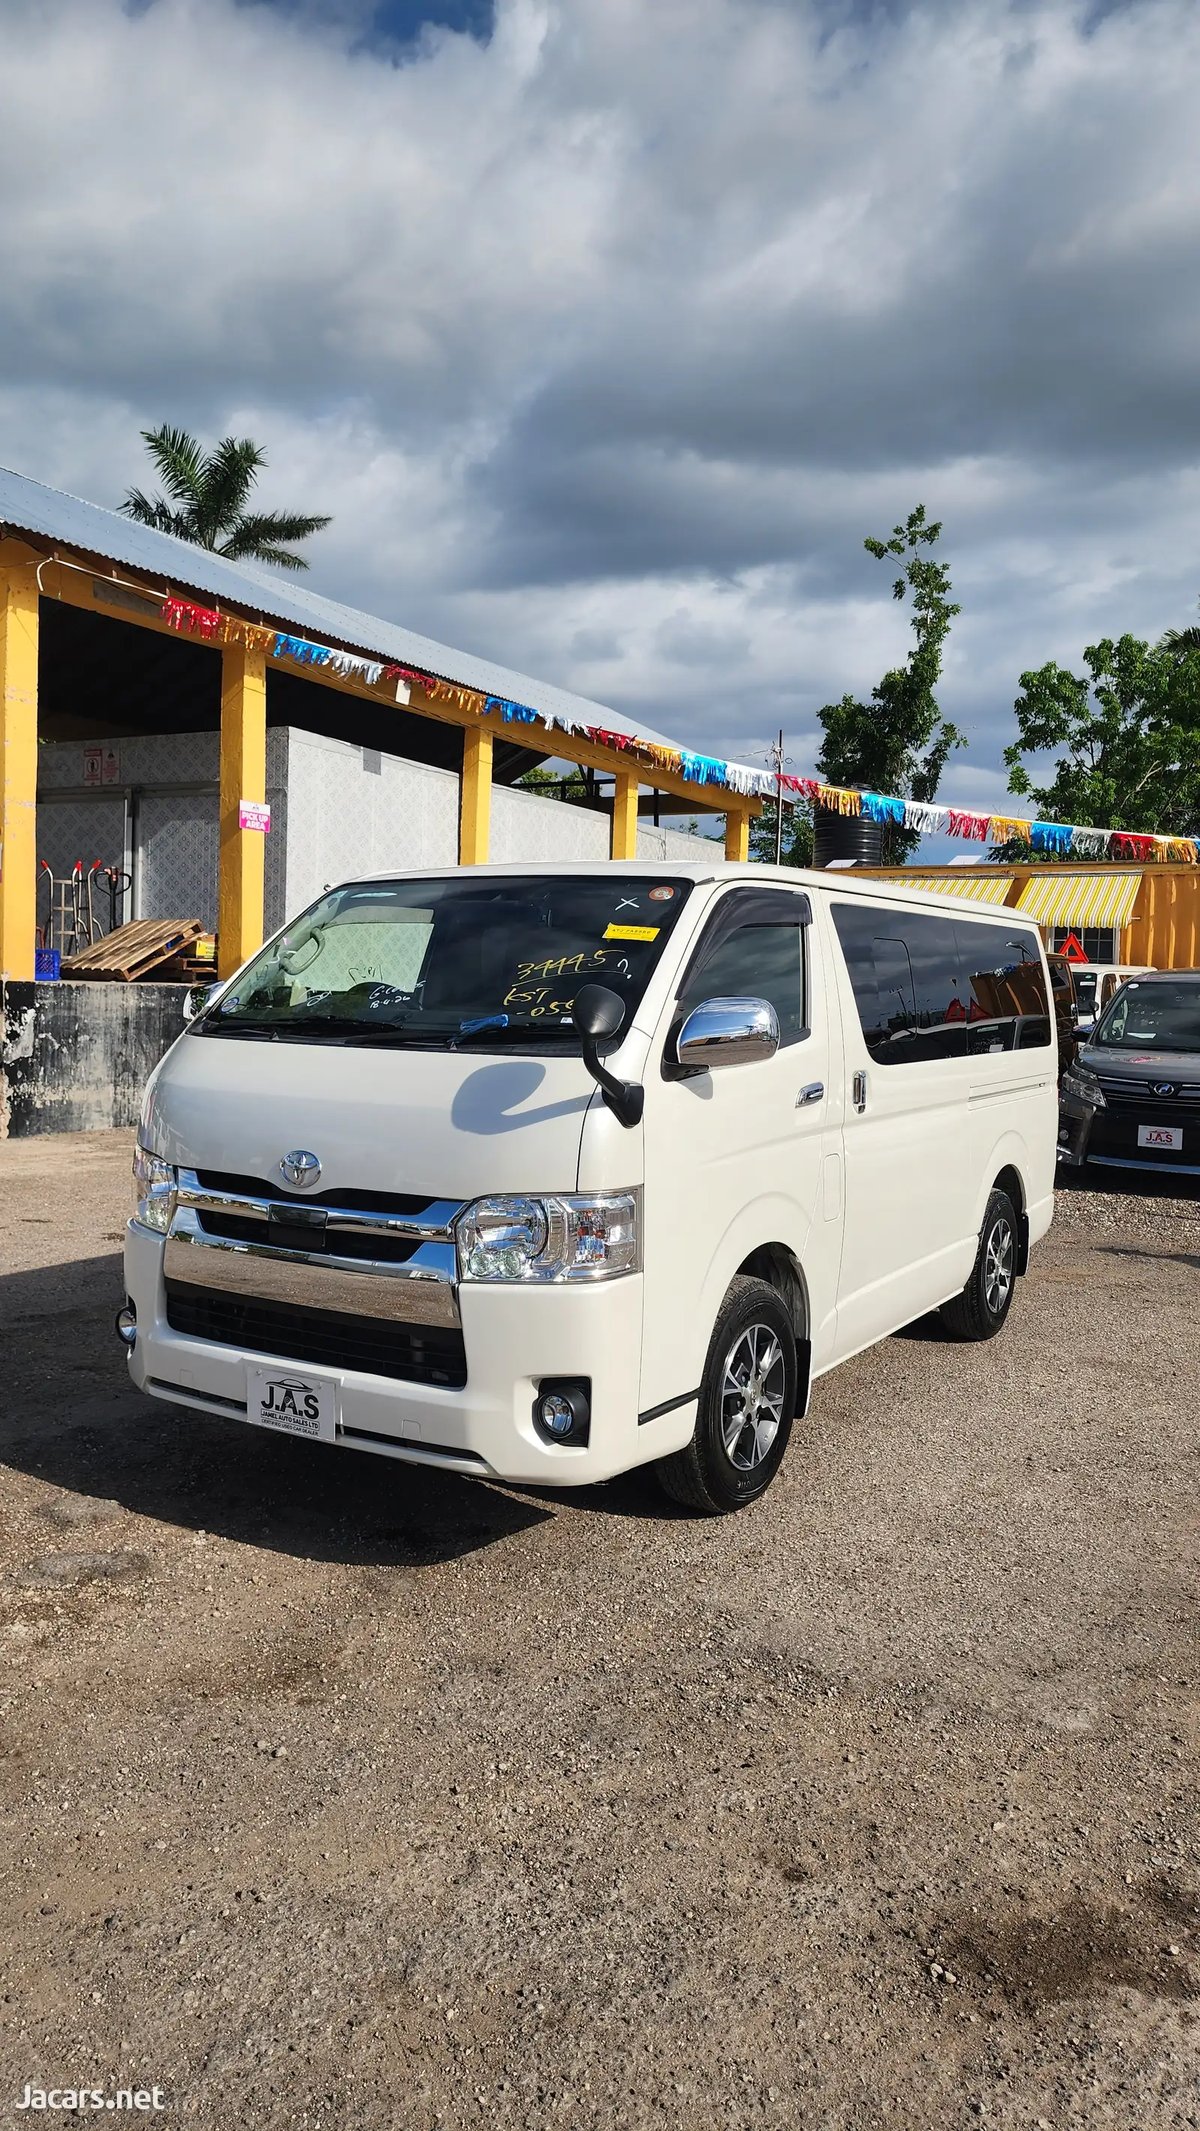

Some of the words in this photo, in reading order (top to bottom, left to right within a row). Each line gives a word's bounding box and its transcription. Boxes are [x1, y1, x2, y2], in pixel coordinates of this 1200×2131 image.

[241, 811, 258, 821] PICK
[258, 814, 269, 823] UP
[246, 819, 266, 830] AREA
[1145, 1132, 1173, 1143] J.A.S
[261, 1386, 320, 1420] J.A.S
[279, 1414, 292, 1422] AUTO
[293, 1418, 308, 1426] SALES
[302, 1428, 319, 1436] DEALER
